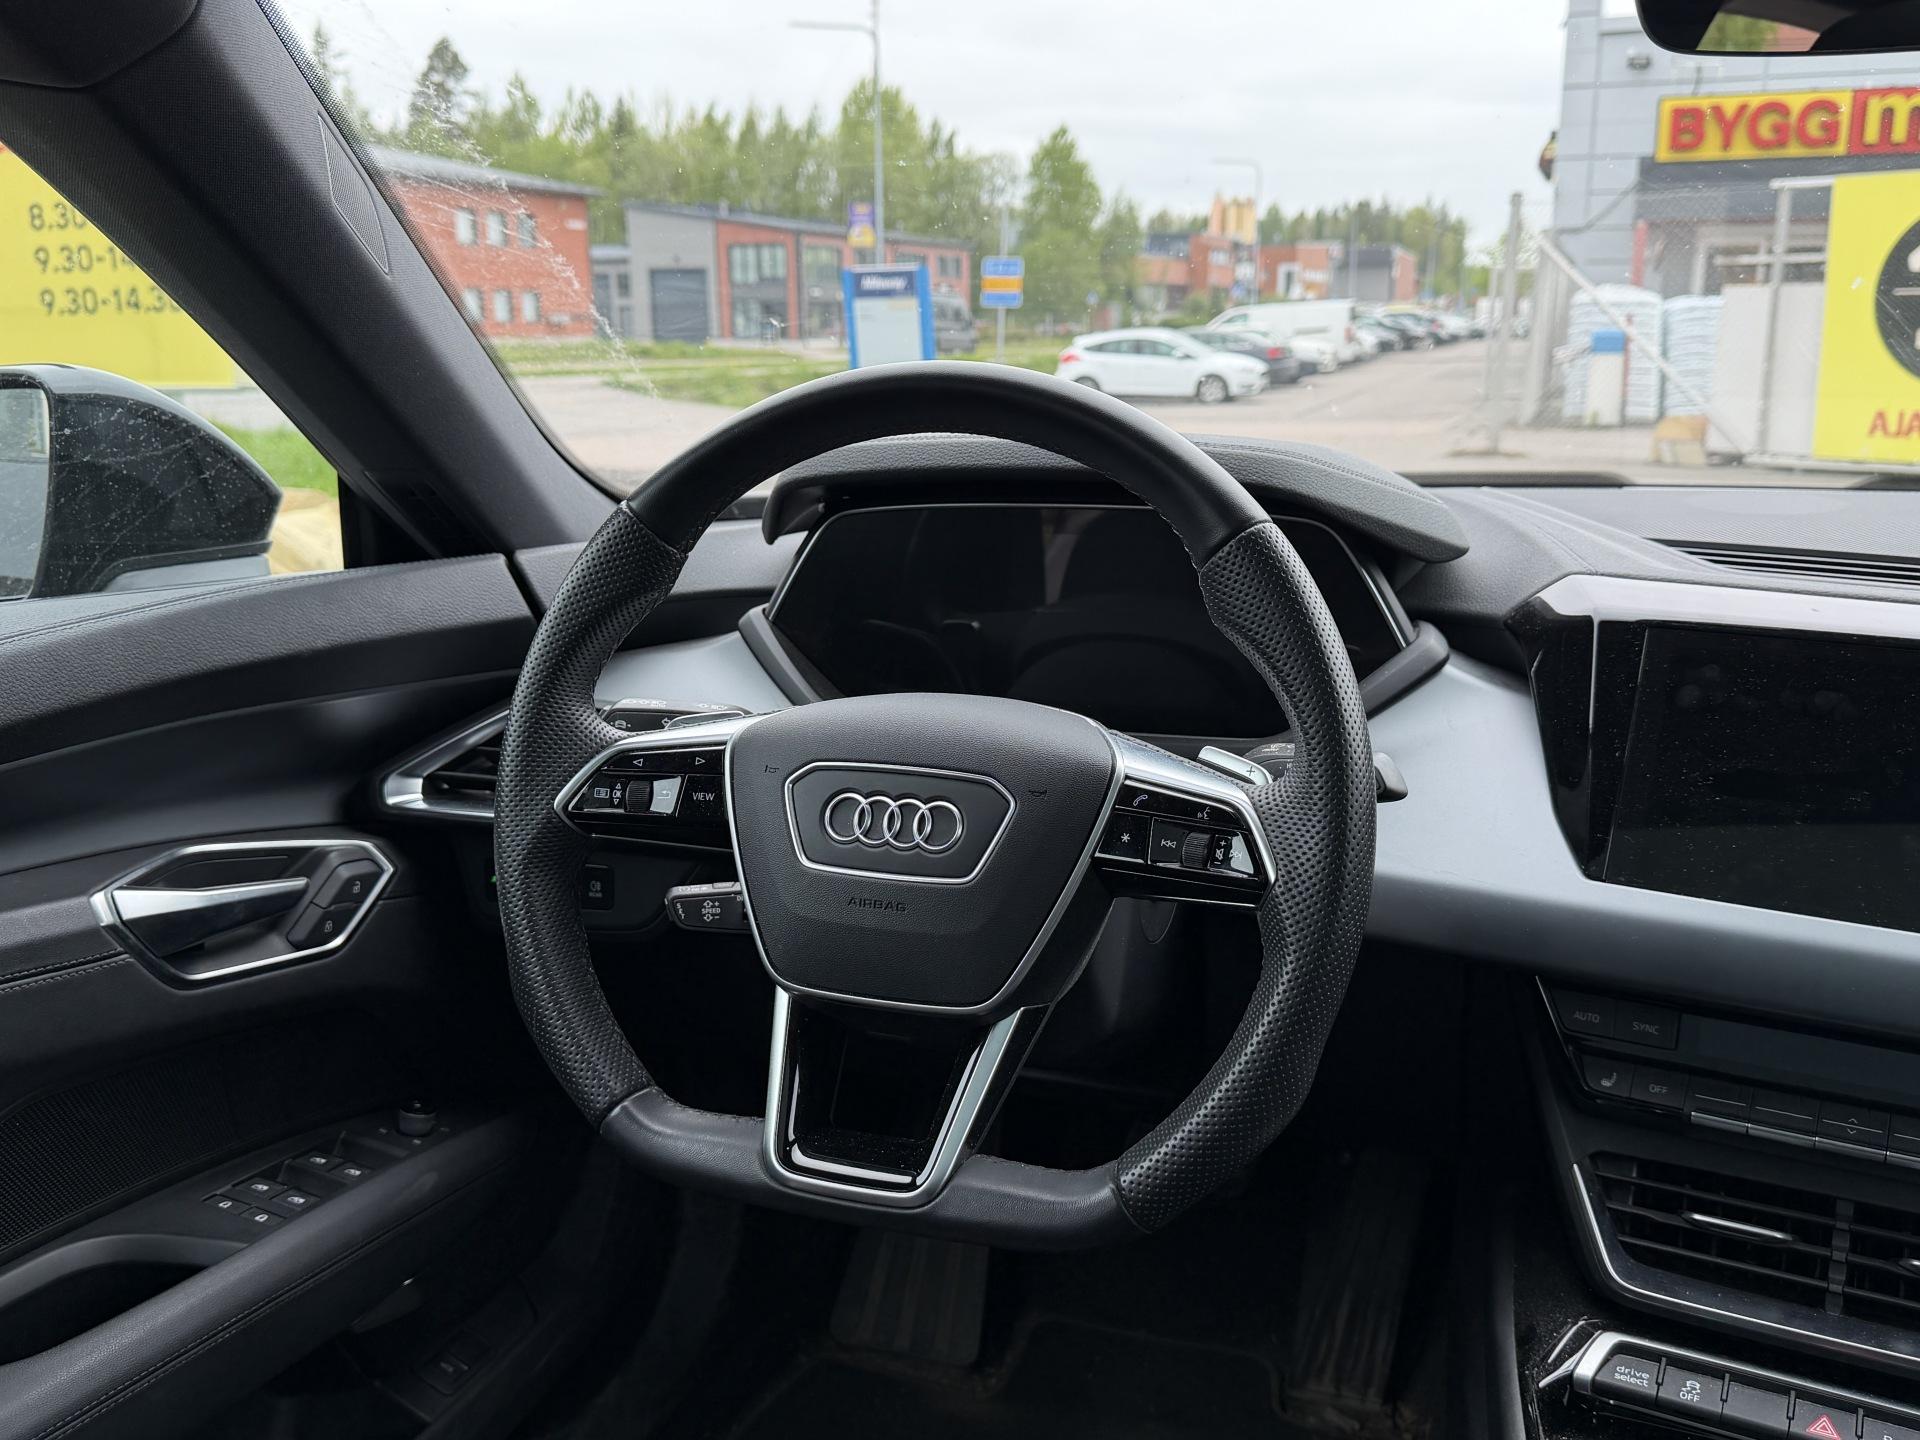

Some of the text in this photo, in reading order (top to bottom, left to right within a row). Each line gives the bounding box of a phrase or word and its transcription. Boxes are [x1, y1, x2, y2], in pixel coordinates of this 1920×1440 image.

[1670, 100, 1840, 151] BYGG
[40, 286, 181, 315] 9.30-14.3
[612, 789, 622, 798] OK
[692, 792, 715, 801] VIEW
[847, 897, 907, 913] AIRBAG
[1573, 1010, 1600, 1024] AUTO
[1632, 1020, 1660, 1035] SYNC
[1649, 1084, 1669, 1095] OFF
[1614, 1372, 1649, 1388] select
[1616, 1365, 1650, 1380] drive
[1679, 1391, 1701, 1403] OFF
